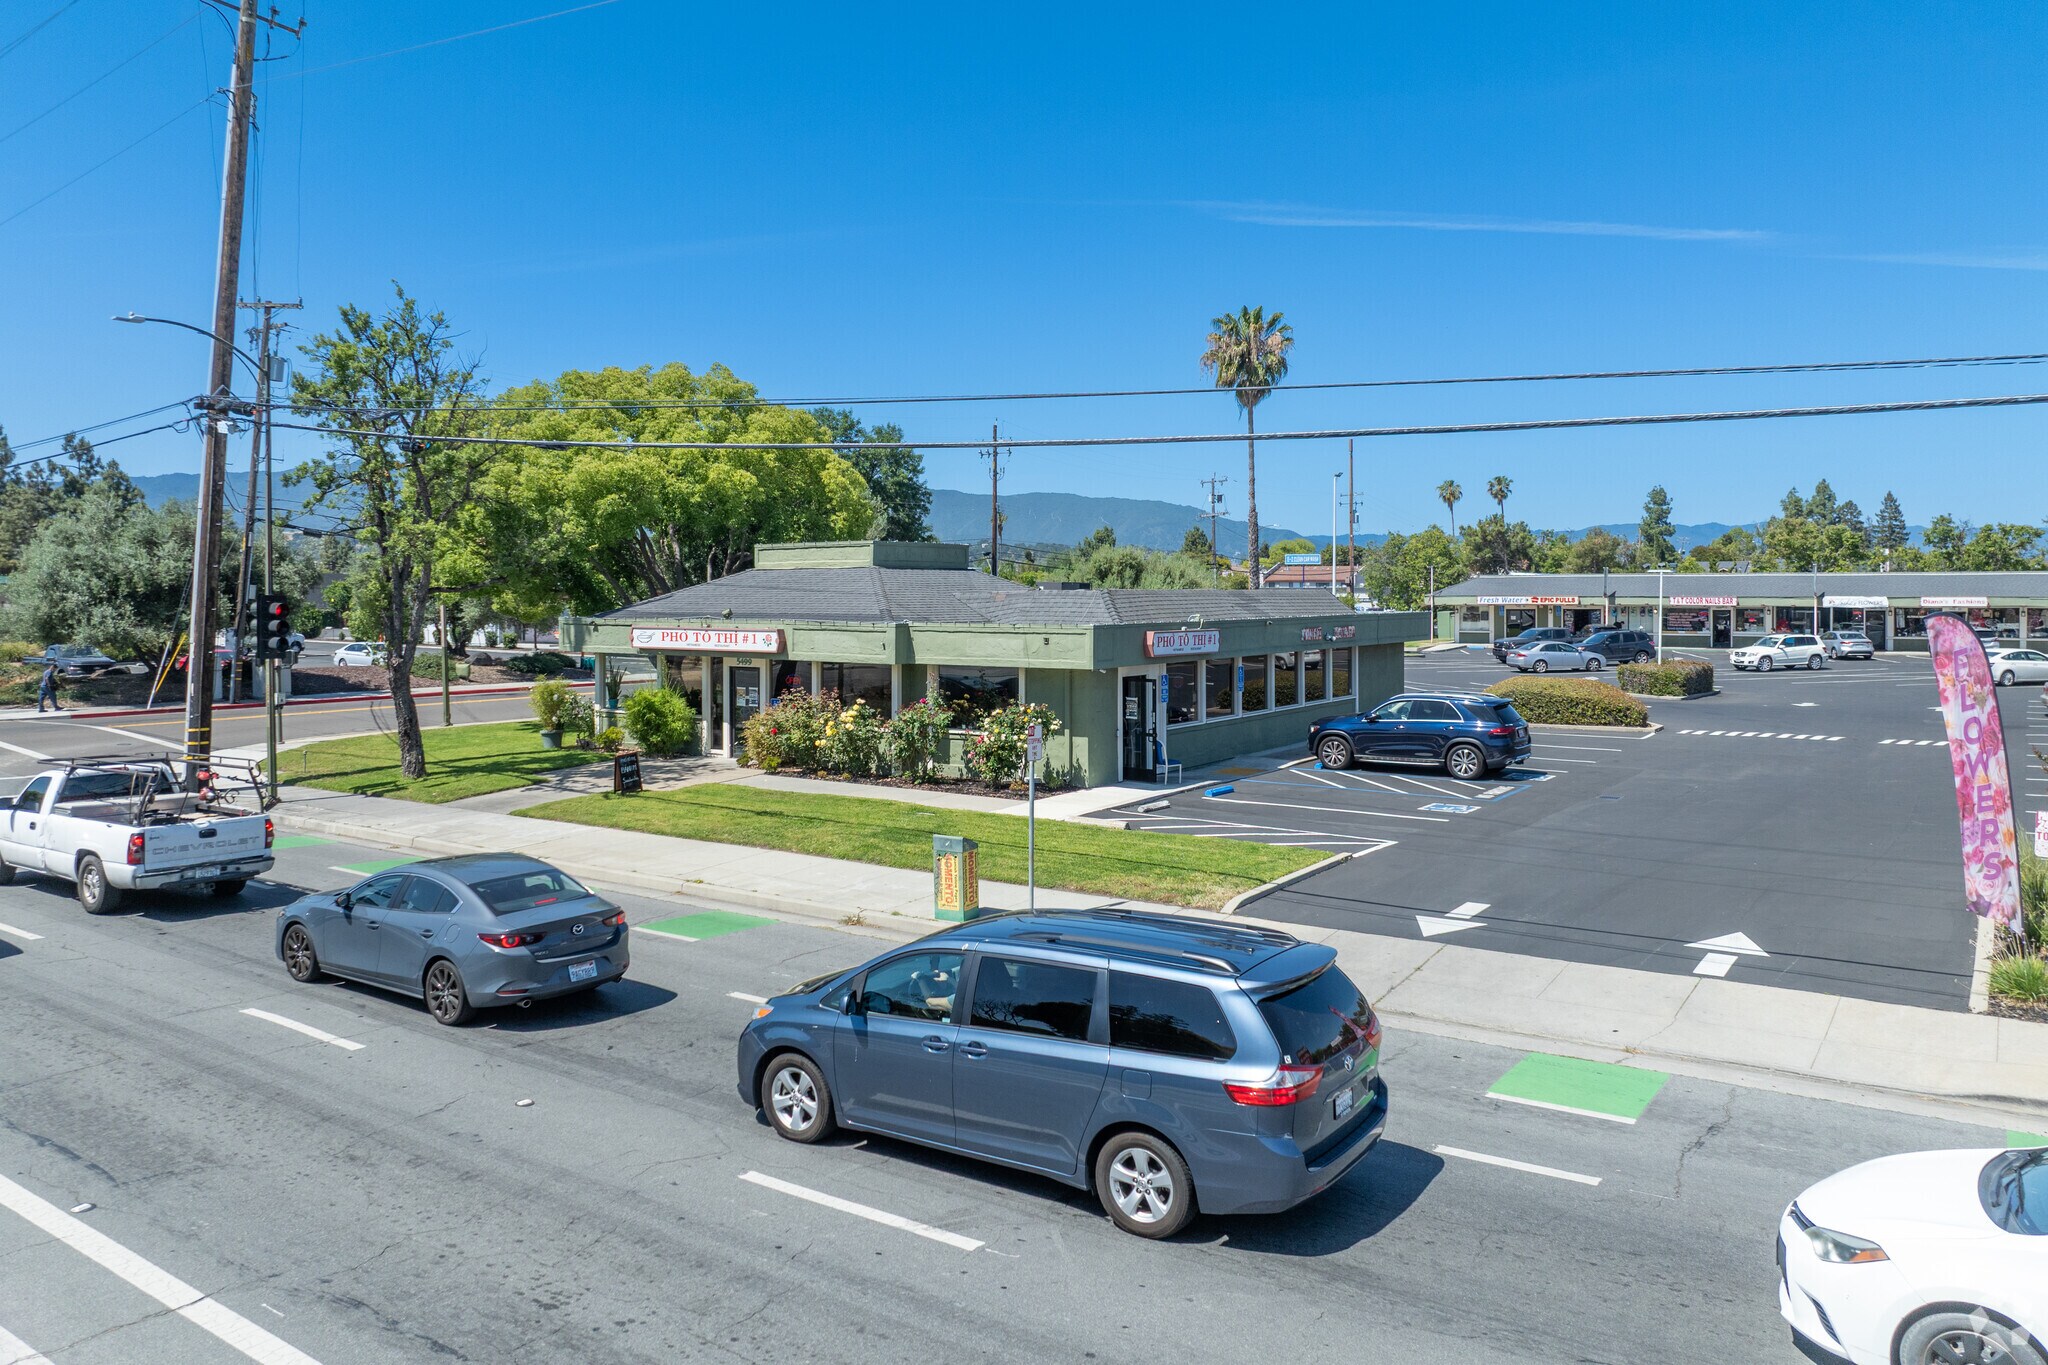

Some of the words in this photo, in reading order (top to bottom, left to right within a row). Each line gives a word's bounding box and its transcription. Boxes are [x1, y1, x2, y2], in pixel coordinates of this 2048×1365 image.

[736, 657, 752, 666] 5499
[1953, 648, 2001, 881] FLOWERS
[152, 836, 259, 855] CHEVROLET
[967, 850, 975, 902] MOMENTO
